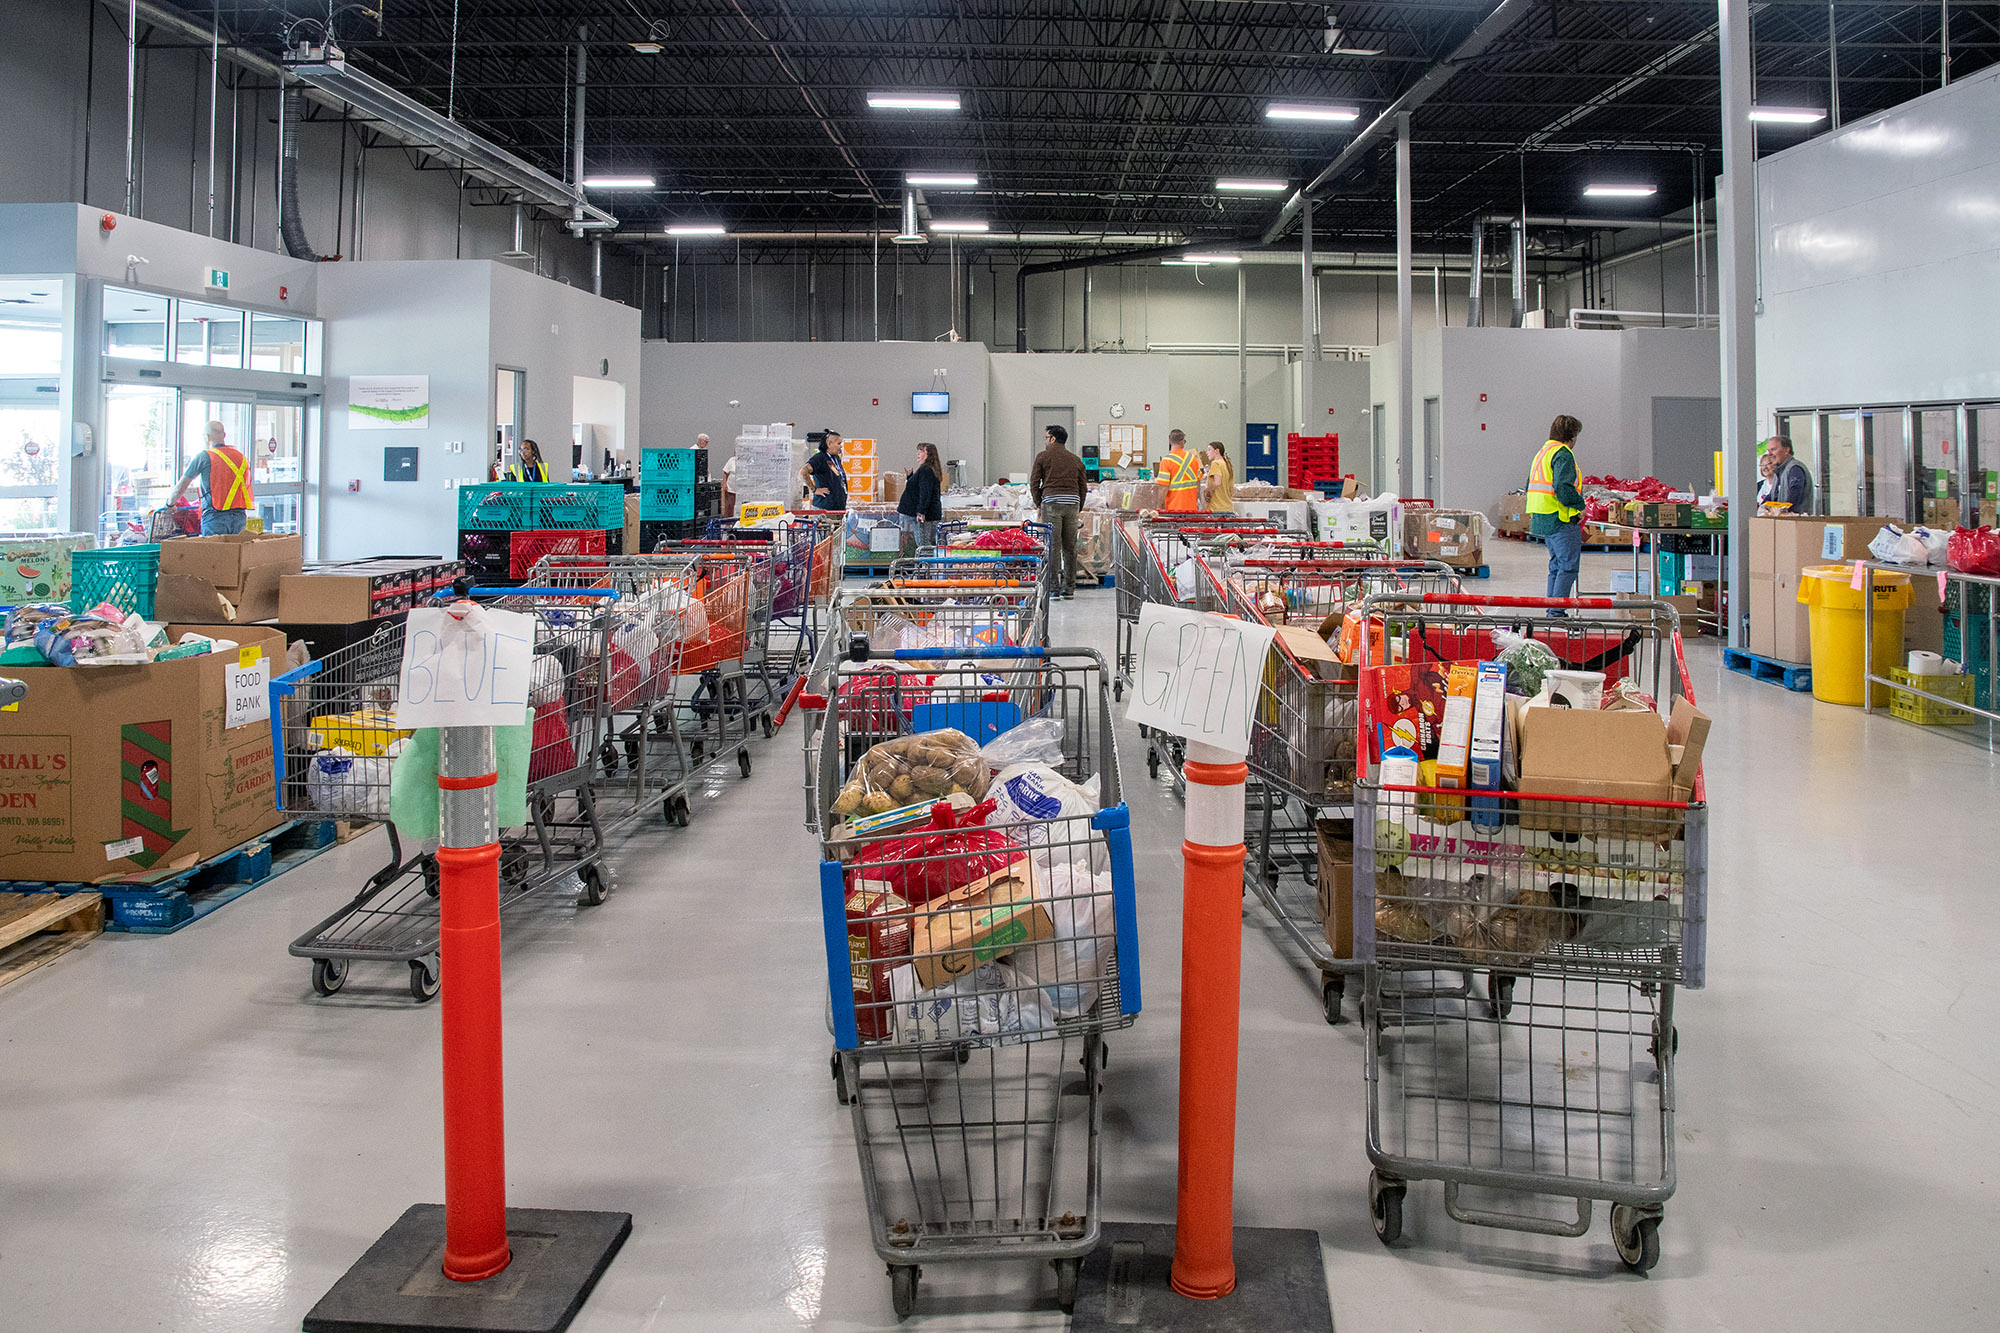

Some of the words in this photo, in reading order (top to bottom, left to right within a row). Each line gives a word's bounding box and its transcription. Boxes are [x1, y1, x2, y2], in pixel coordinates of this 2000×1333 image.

[1873, 585, 1897, 593] RUTE
[408, 629, 527, 705] BLUE
[1450, 669, 1475, 677] Cheerios
[235, 672, 261, 689] FOOD
[1142, 621, 1268, 741] GREEN
[235, 695, 261, 712] BANK
[1418, 712, 1427, 751] CINNAMON
[1425, 721, 1433, 745] BOLTS
[236, 771, 272, 794] GARDEN
[1026, 775, 1045, 791] BANK
